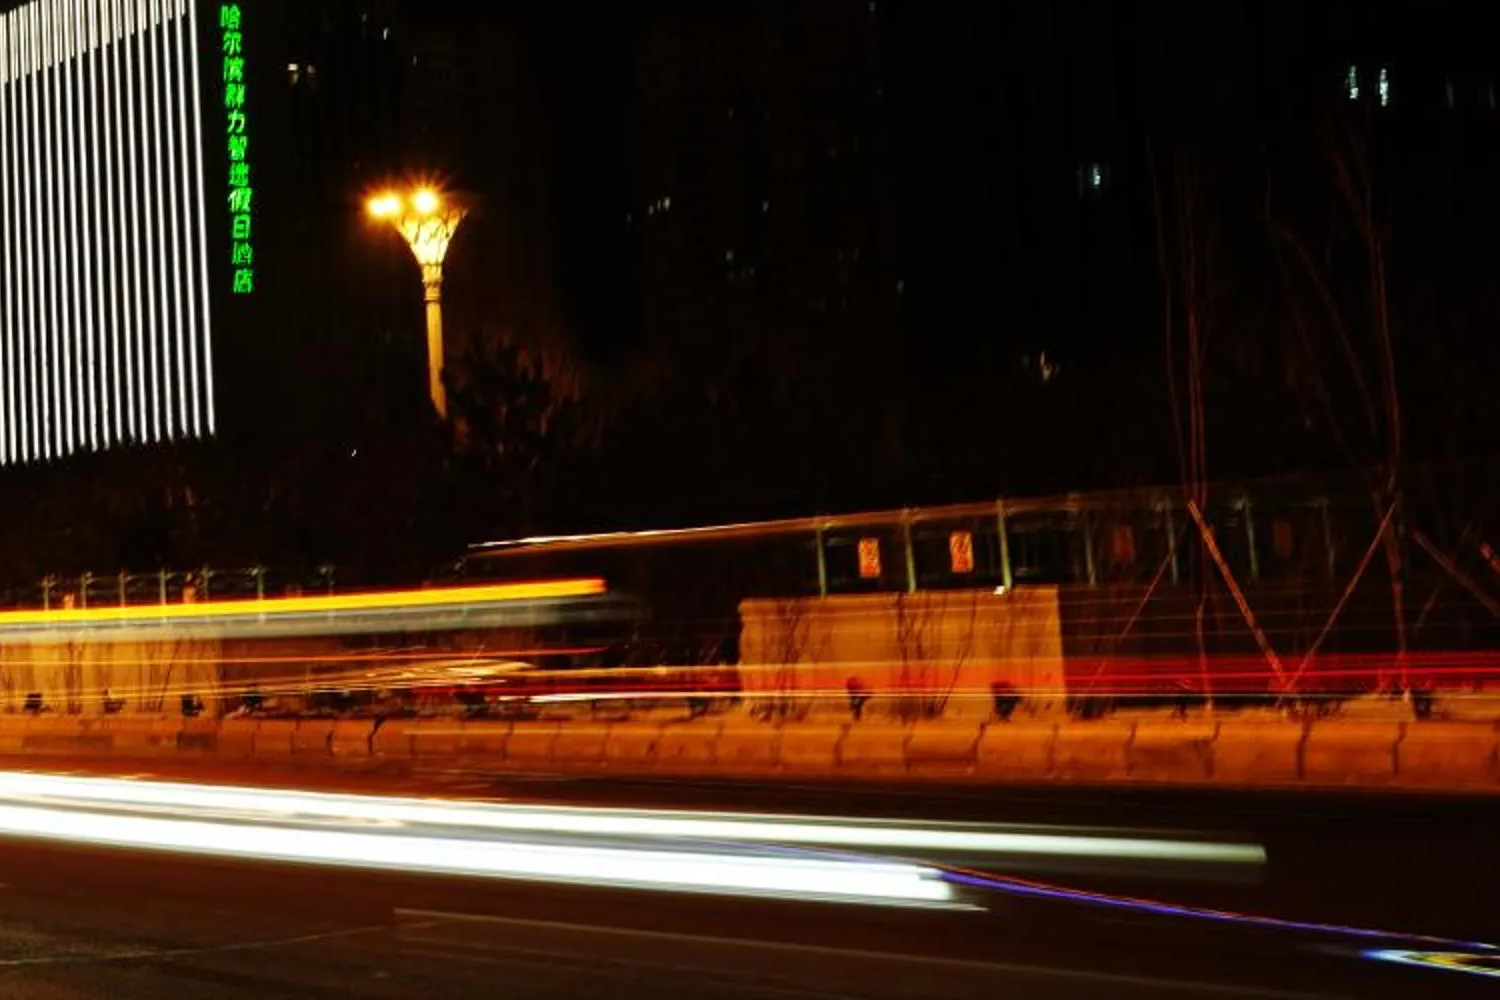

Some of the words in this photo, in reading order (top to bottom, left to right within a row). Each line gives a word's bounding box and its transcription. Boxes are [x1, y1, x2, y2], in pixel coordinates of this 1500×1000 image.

[220, 5, 253, 293] 哈尔滨群力智选假日酒店
